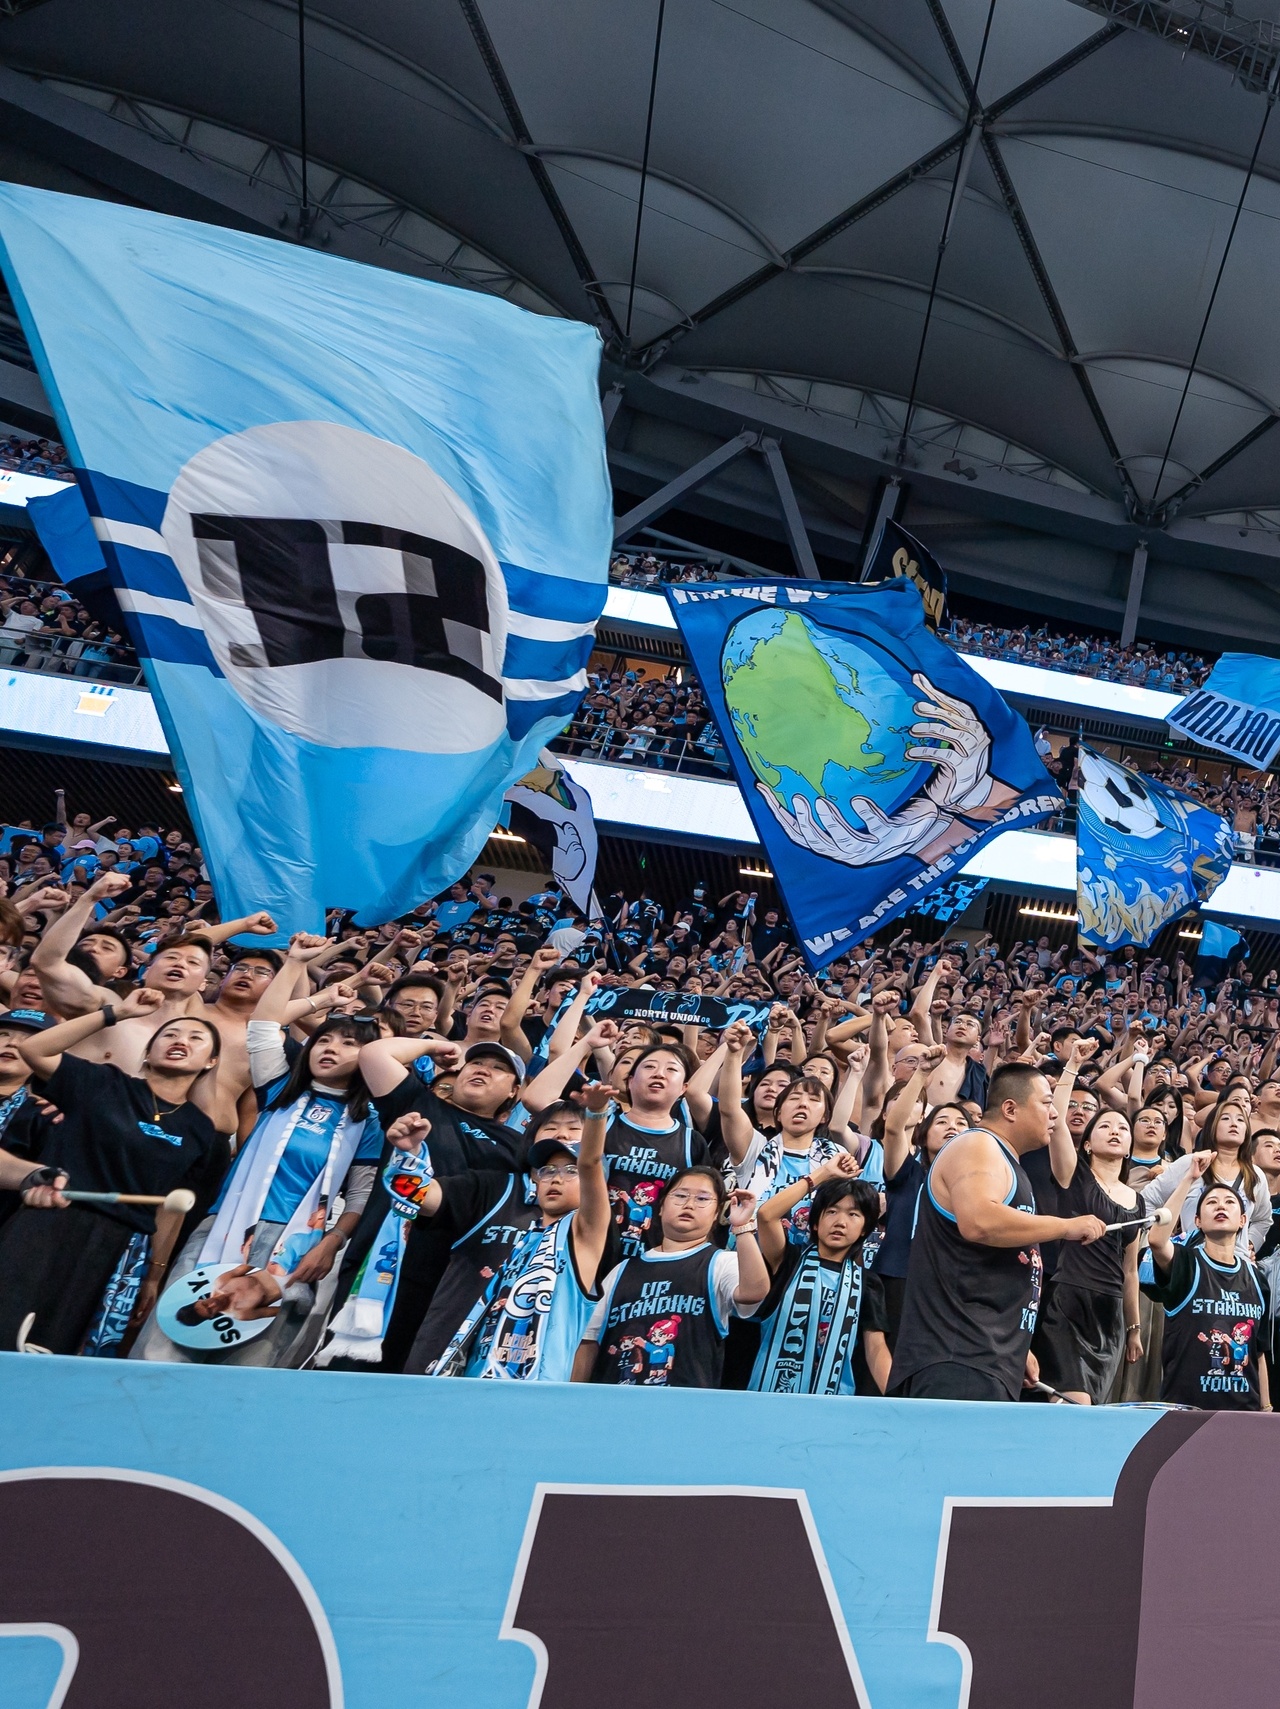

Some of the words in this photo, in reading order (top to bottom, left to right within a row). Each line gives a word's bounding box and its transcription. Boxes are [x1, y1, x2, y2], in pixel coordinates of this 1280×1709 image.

[803, 927, 853, 956] WE
[858, 888, 908, 930] ARE
[906, 854, 956, 891] THE
[634, 1008, 669, 1020] NORTH
[669, 1012, 701, 1023] UNION
[606, 1154, 680, 1180] TANDIN
[641, 1280, 672, 1298] UP
[608, 1294, 706, 1328] STANDING
[1200, 1375, 1250, 1393] YOUTH
